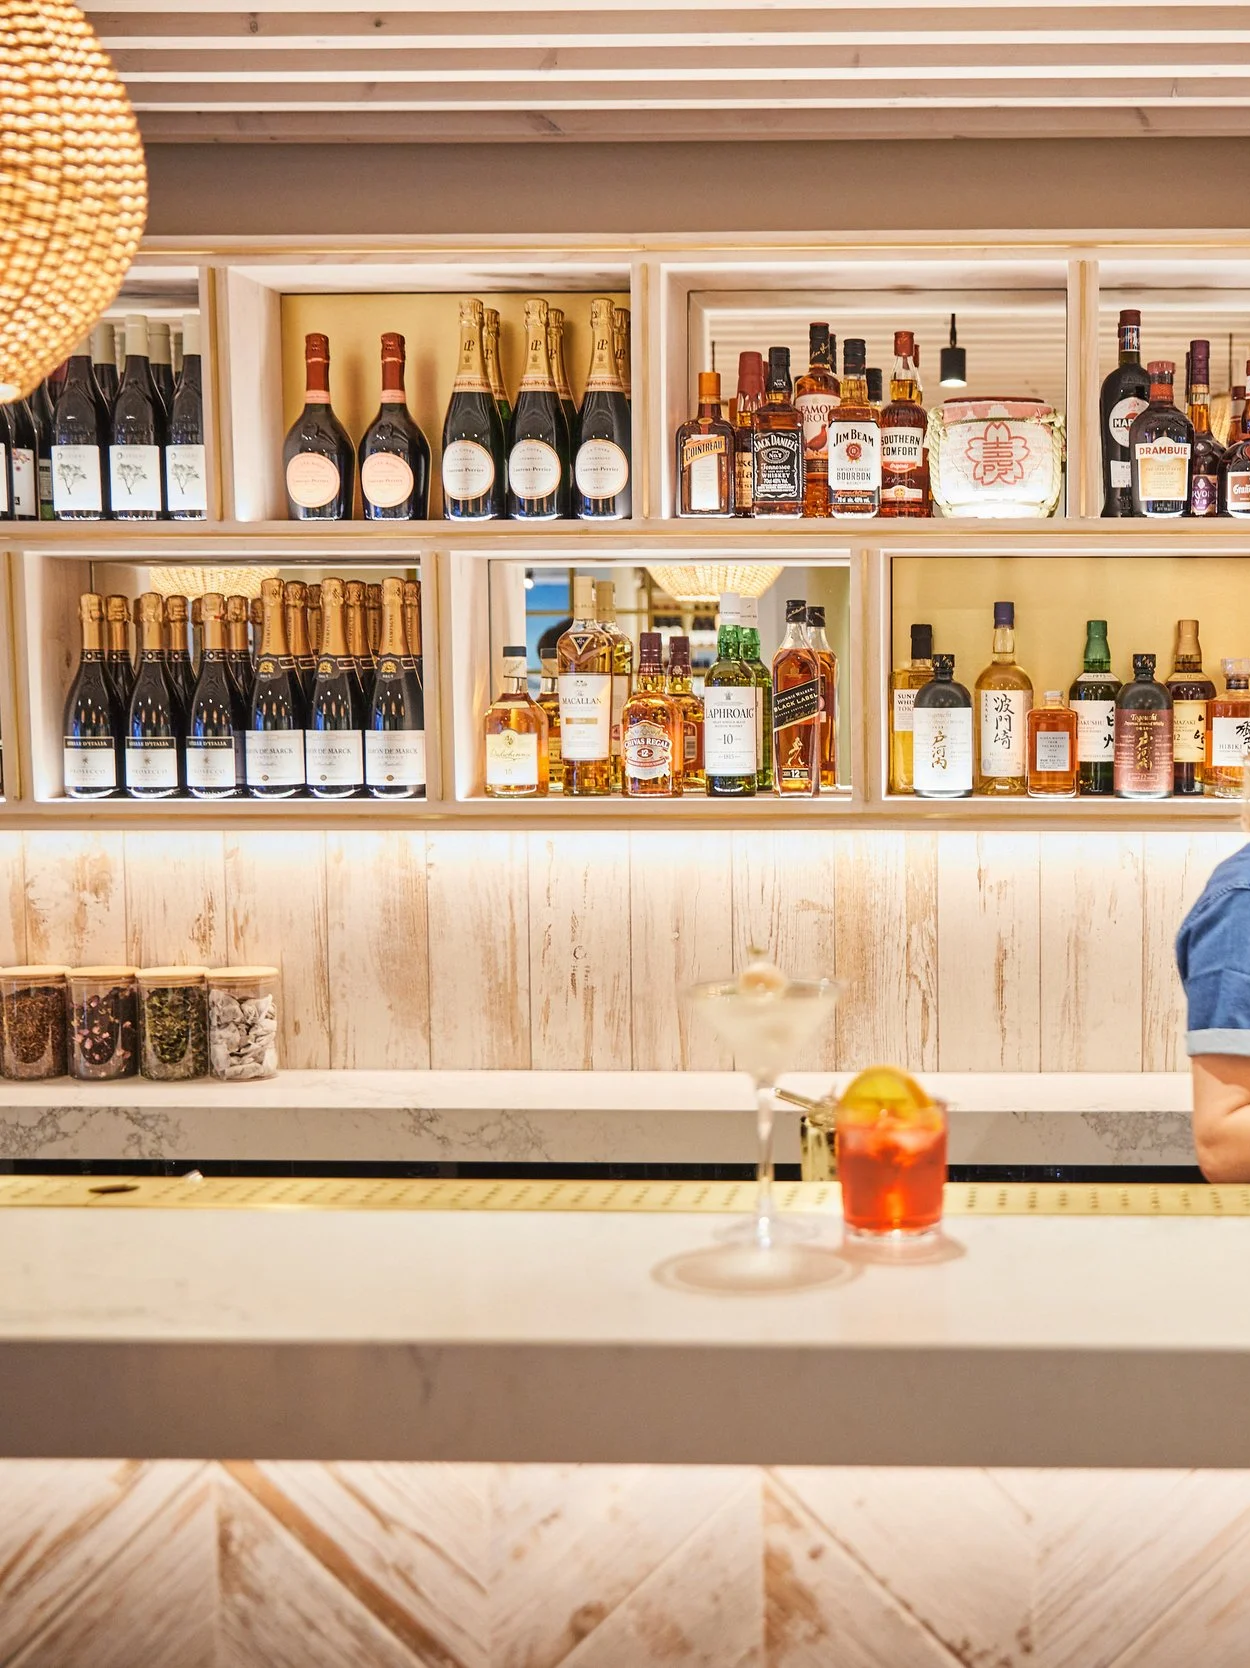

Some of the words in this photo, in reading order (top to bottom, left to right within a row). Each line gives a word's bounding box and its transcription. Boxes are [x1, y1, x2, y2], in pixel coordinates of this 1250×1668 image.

[833, 432, 849, 447] JIM
[850, 428, 874, 447] BEAM
[881, 434, 920, 446] SOUTHERN
[753, 437, 771, 453] JACK
[771, 434, 799, 451] DANIEL'S
[685, 440, 723, 462] COINTREAU
[882, 446, 918, 456] COMFORT
[1139, 446, 1188, 455] DRAMBUIE
[836, 472, 871, 481] BOURBON
[774, 699, 796, 713] BLACK
[796, 692, 818, 706] LABEL
[706, 708, 754, 719] LAPHROAIG
[1130, 713, 1158, 721] Togouchi
[624, 738, 645, 748] CHIVAS
[646, 738, 670, 748] REGAL
[722, 733, 734, 745] 10
[641, 749, 649, 757] 12
[790, 769, 800, 778] 12
